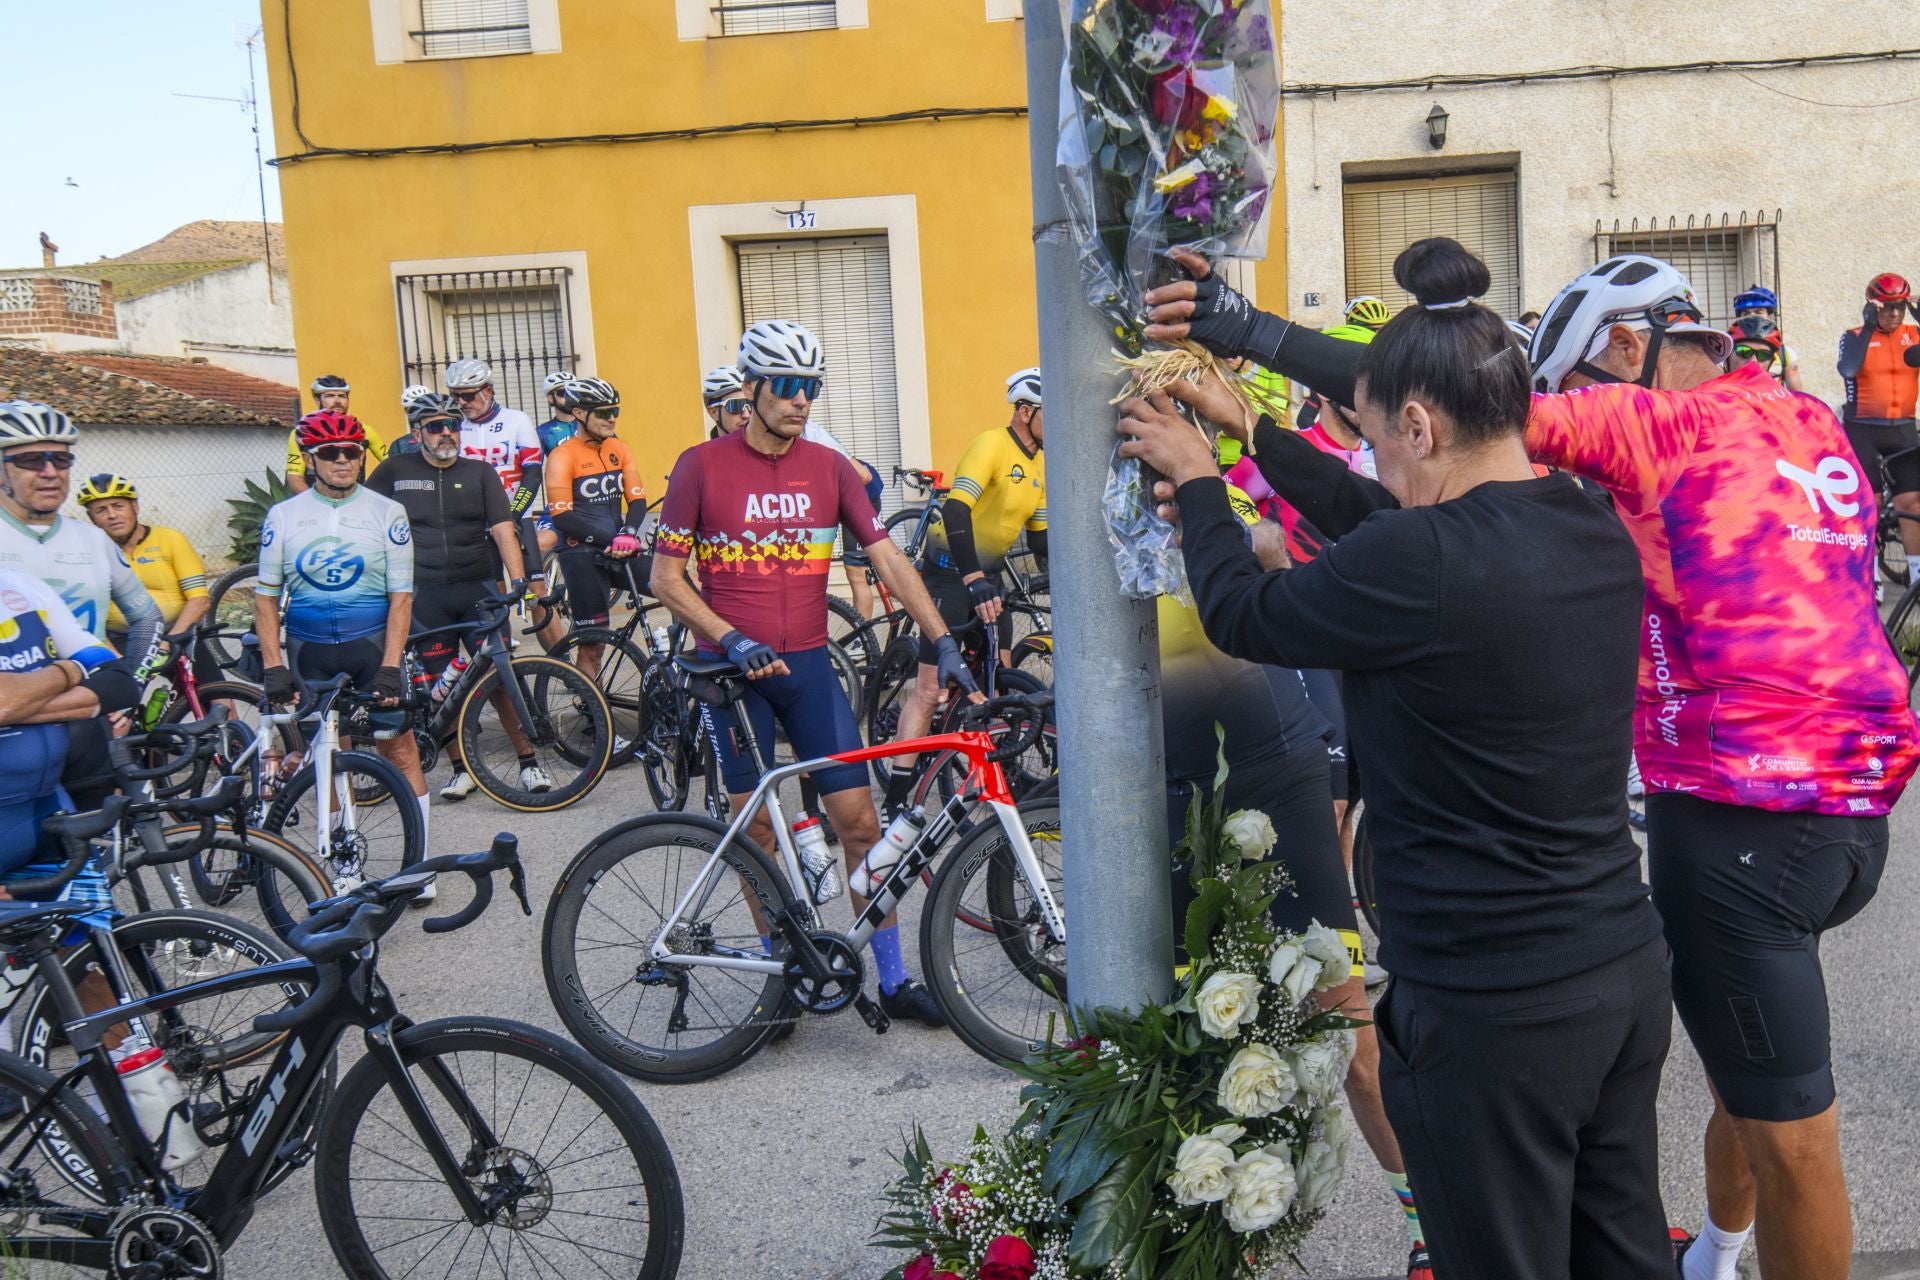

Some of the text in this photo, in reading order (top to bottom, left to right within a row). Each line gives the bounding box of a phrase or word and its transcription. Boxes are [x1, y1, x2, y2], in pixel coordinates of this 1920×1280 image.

[789, 212, 816, 228] 137
[744, 493, 811, 522] ACDP
[1786, 524, 1868, 550] TotalEnergies
[0, 645, 46, 671] RGIA
[1860, 735, 1897, 745] GSPORT
[1762, 757, 1808, 767] COMUNITAT
[563, 971, 670, 1064] CORIMA
[240, 1036, 308, 1159] BH
